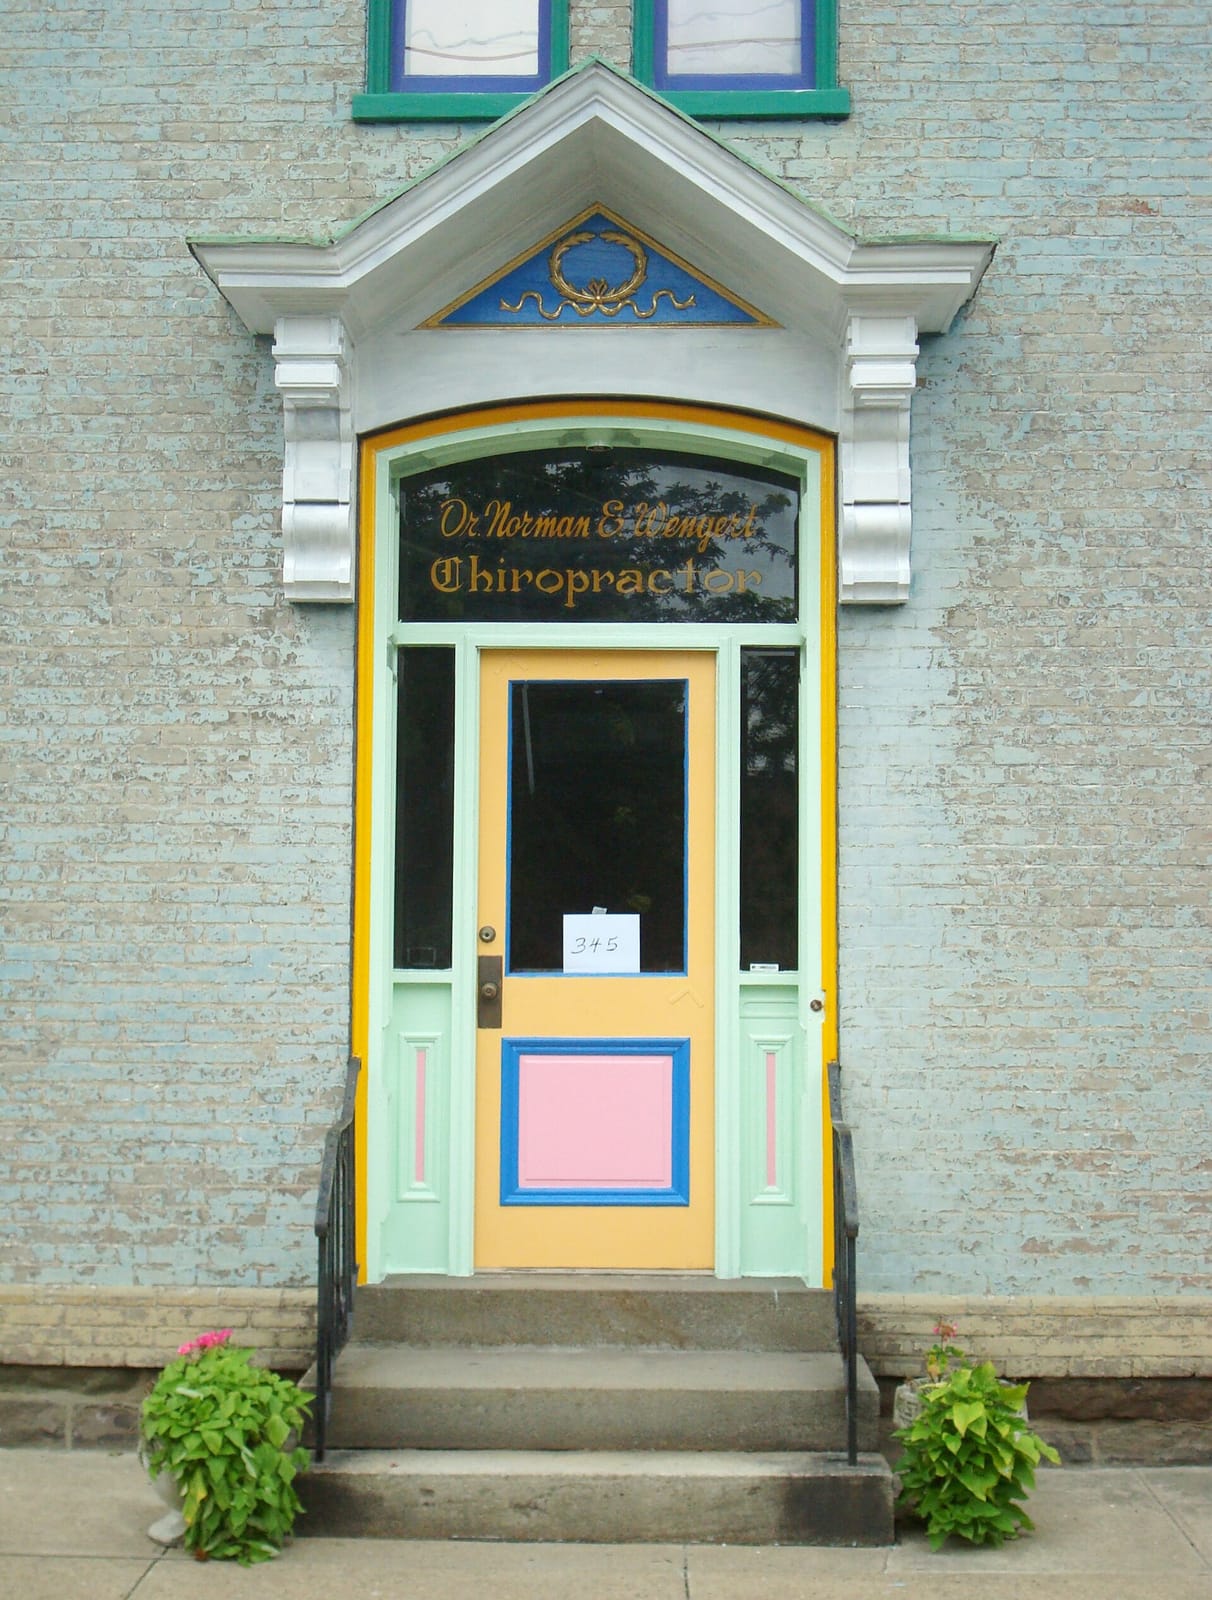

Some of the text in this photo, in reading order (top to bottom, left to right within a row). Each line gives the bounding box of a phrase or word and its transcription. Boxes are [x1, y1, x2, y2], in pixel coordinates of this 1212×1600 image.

[484, 499, 591, 537] Norman
[634, 501, 758, 553] Wengert
[430, 555, 763, 608] Chiropractor
[570, 936, 618, 954] 345
